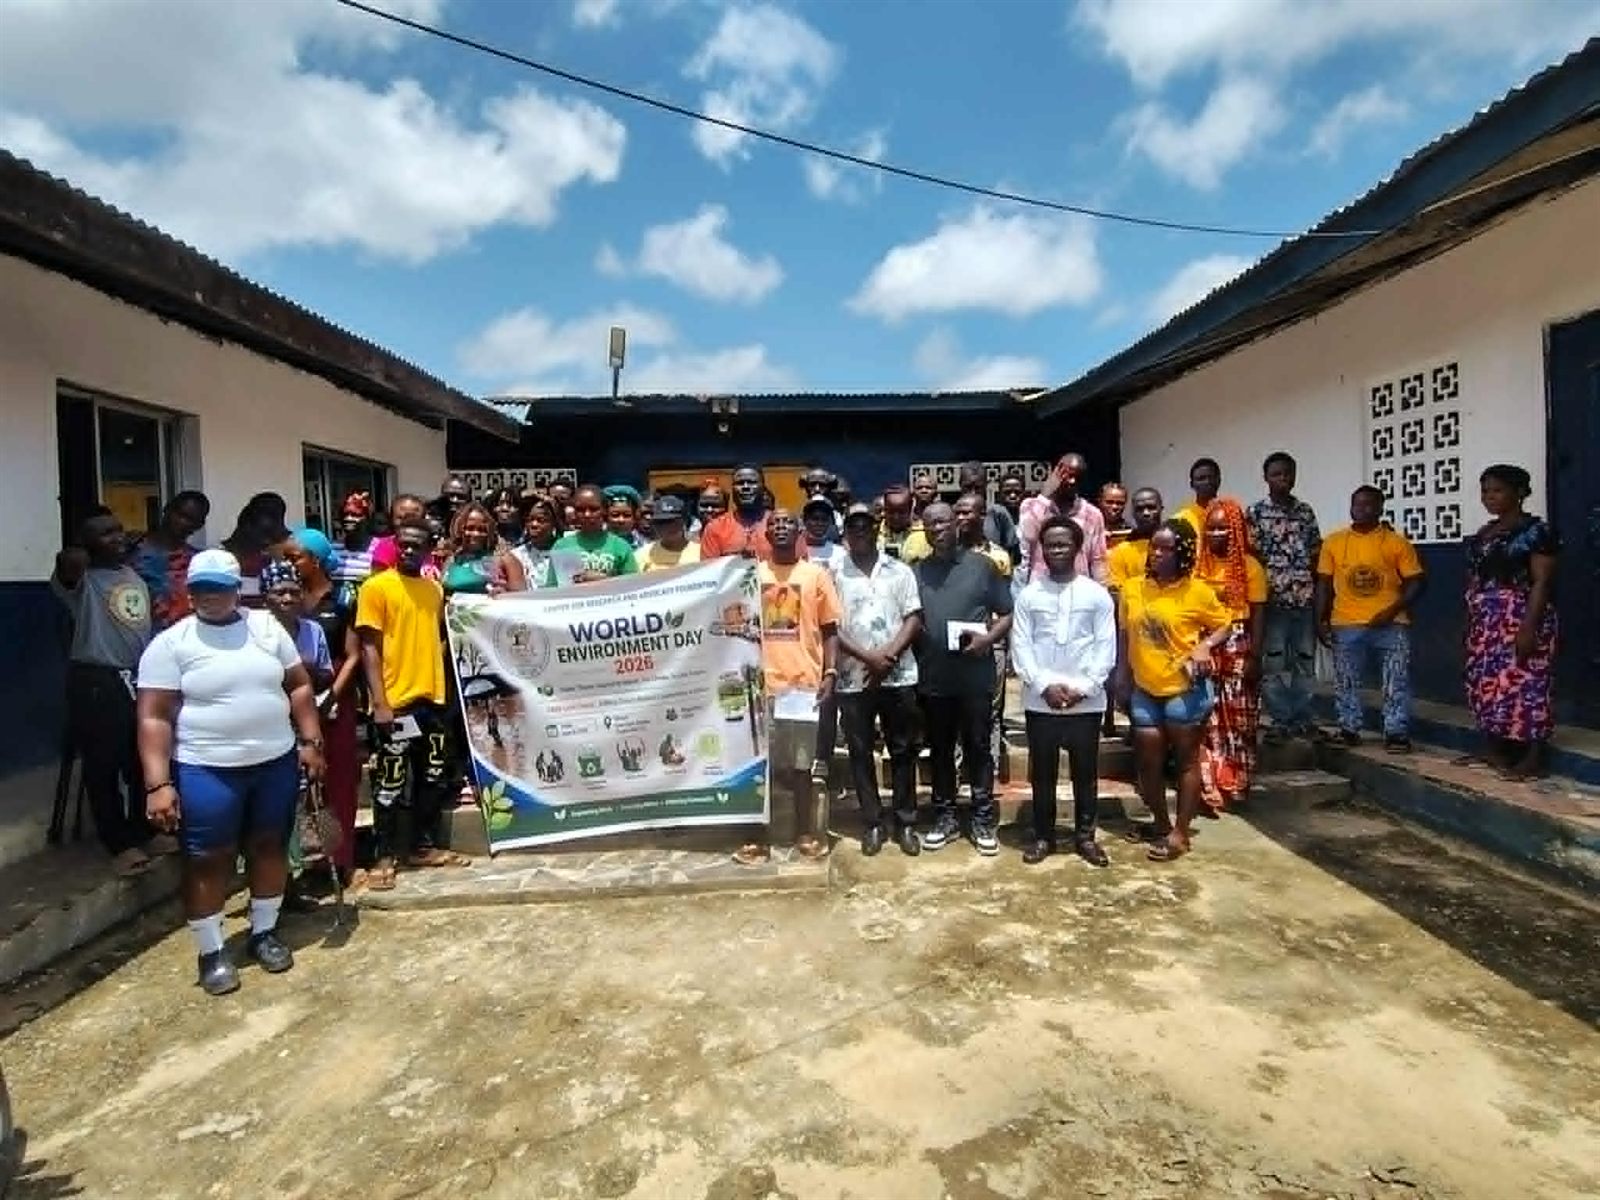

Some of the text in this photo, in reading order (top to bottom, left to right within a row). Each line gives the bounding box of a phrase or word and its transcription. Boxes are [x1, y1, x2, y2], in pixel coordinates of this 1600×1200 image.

[569, 612, 663, 643] WORLD
[557, 634, 670, 664] ENVIRONMENT
[674, 629, 704, 650] DAY
[614, 655, 654, 675] 2026
